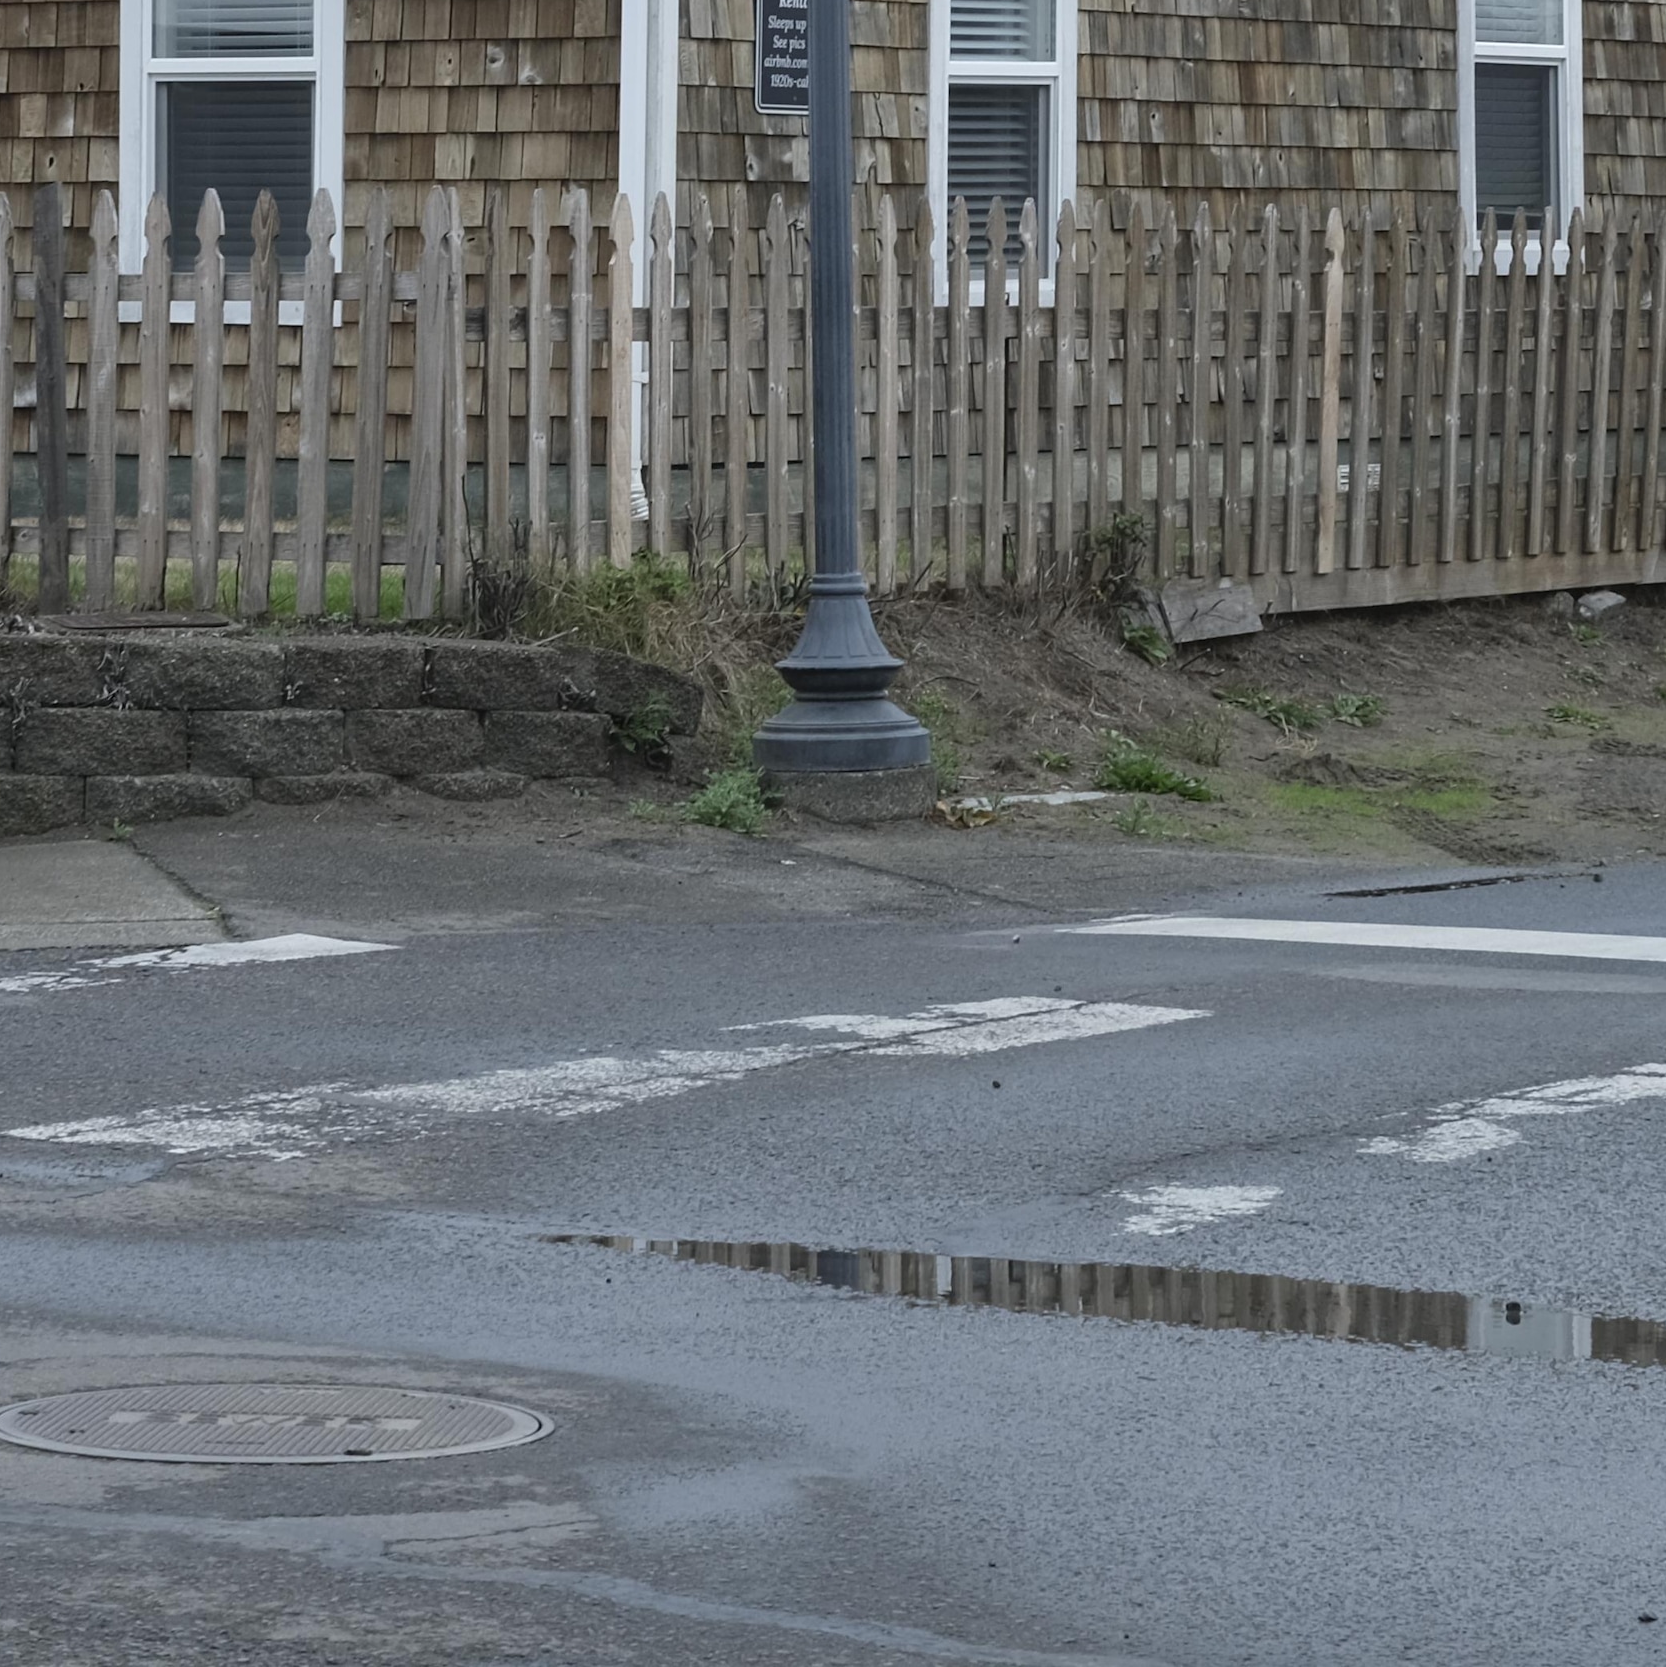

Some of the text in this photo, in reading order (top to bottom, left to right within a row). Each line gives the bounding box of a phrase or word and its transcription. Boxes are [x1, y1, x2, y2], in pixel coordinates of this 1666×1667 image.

[768, 15, 807, 34] Sleeps up
[773, 35, 806, 52] See pics
